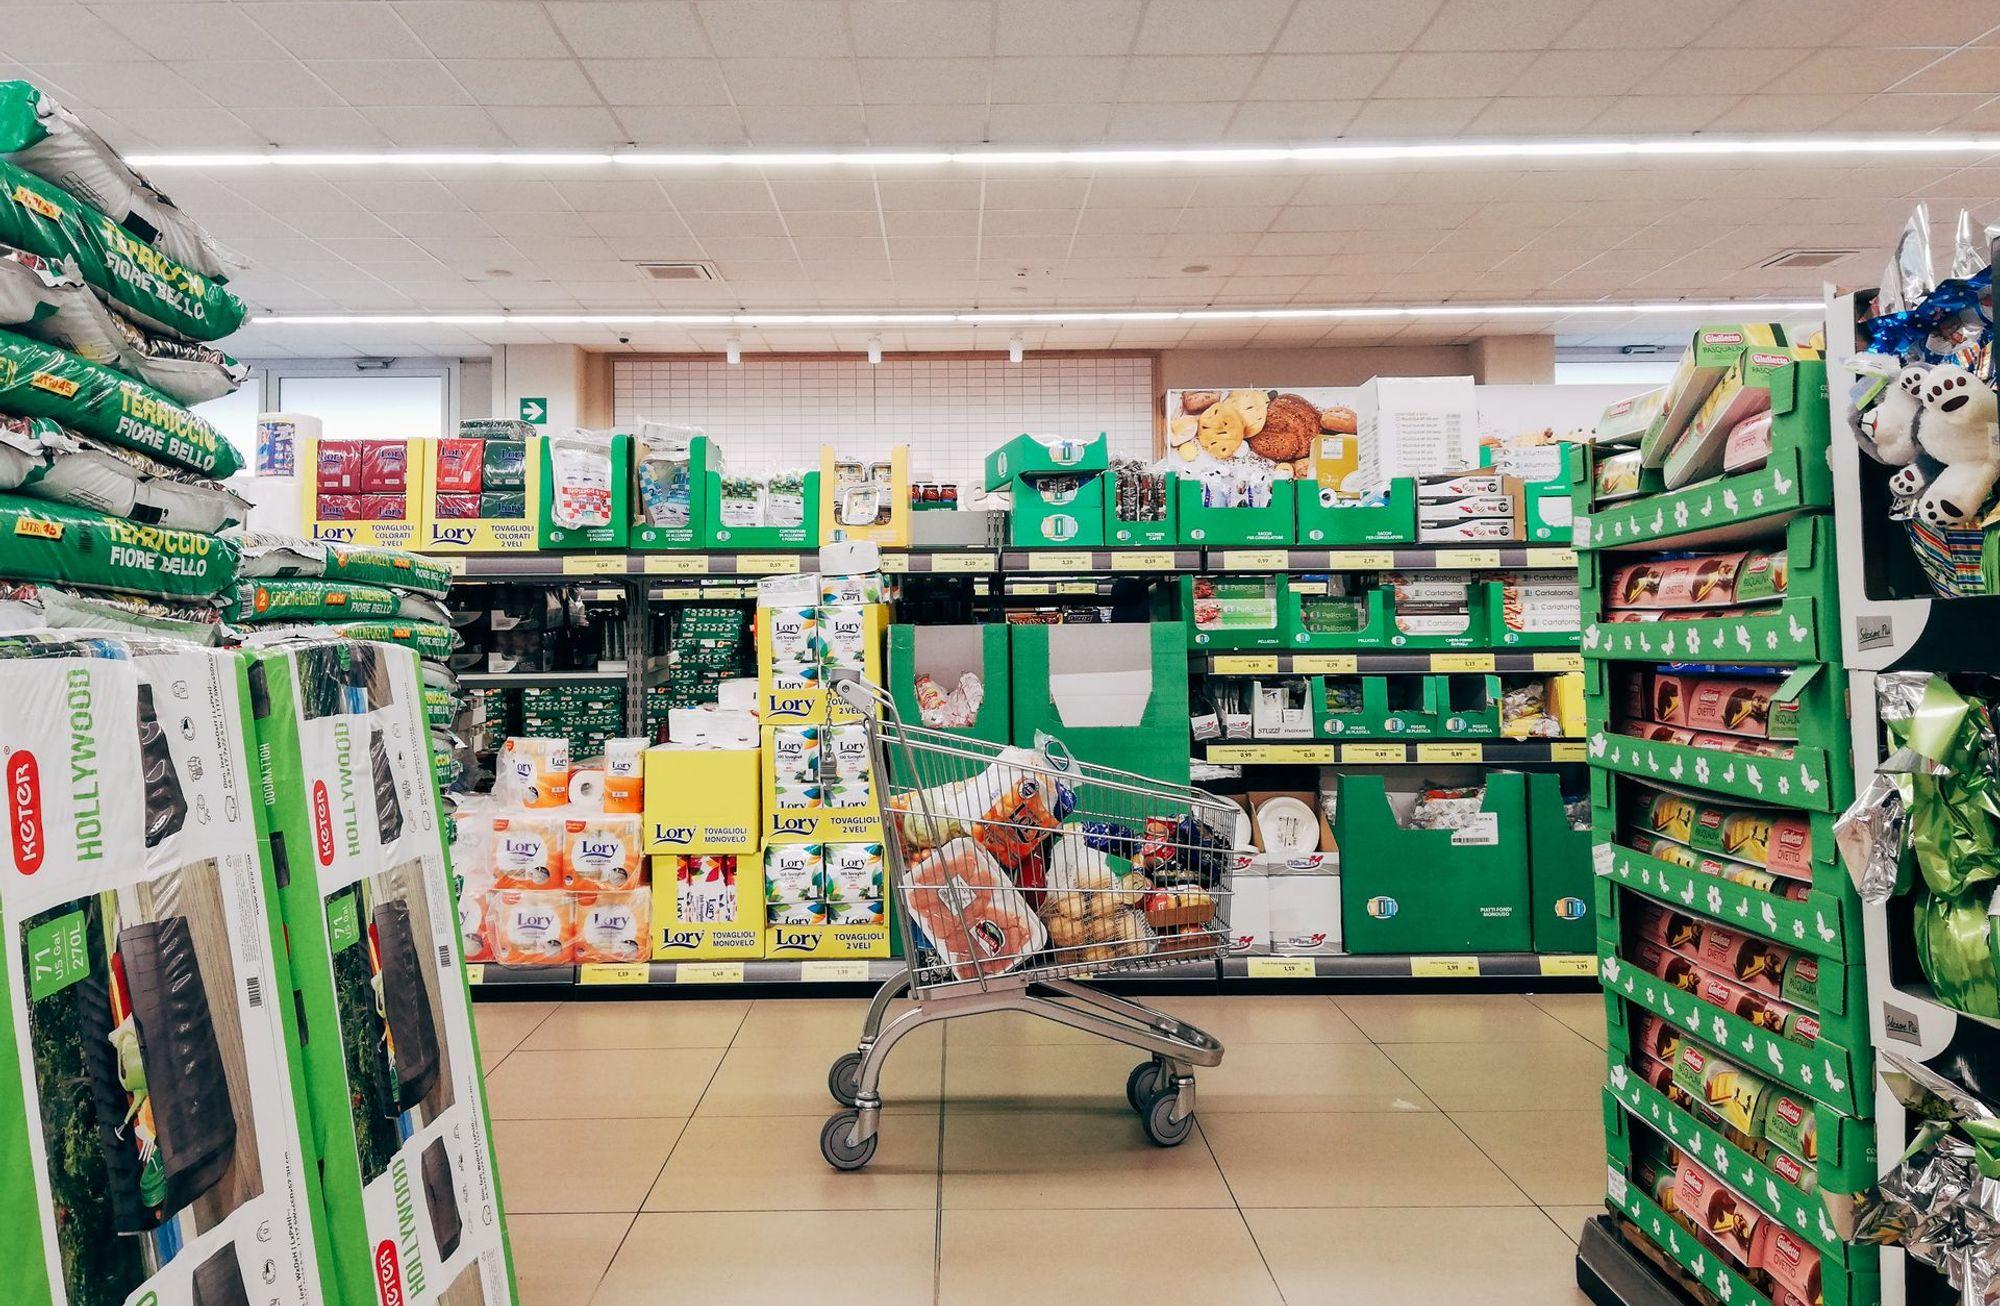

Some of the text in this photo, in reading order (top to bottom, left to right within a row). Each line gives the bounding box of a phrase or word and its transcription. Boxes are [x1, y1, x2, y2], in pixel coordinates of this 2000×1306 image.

[105, 250, 205, 320] FIORE BELLO
[119, 385, 216, 452] TERRICCIO
[116, 416, 166, 450] FIORE
[168, 439, 216, 471] BELLO
[103, 517, 210, 556] TERRICCIO
[313, 524, 357, 544] Lory
[374, 532, 411, 540] COLORATI
[432, 524, 477, 544] Lory
[490, 525, 534, 533] TOVAGLIOLI
[109, 546, 208, 577] FIORE BELLO
[350, 602, 392, 614] FIORE BELLO
[775, 622, 801, 634] Lory
[835, 622, 860, 634] Lory
[769, 695, 815, 717] Lory
[778, 741, 803, 753] Lory
[839, 741, 866, 753] Lory
[67, 666, 104, 862] HOLLYWOOD
[612, 761, 632, 771] Lory
[258, 742, 276, 806] HOLLYWOOD
[334, 721, 360, 858] HOLLYWOOD
[14, 762, 38, 862] KETER
[830, 816, 881, 825] TOVAGLIOLI
[313, 790, 333, 858] KETER
[656, 824, 696, 842] Lory
[704, 827, 747, 835] TOVAGLIOLI
[772, 814, 819, 835] Lory
[842, 825, 867, 833] 2 VELI
[506, 839, 541, 856] Lory
[582, 840, 619, 857] Lory
[1777, 849, 1800, 862] OVETTO
[780, 857, 806, 870] Lory
[840, 857, 867, 870] Lory
[333, 916, 345, 940] 71
[517, 912, 554, 928] Lory
[663, 929, 705, 948] Lory
[712, 931, 756, 939] TOVAGLIOLI
[712, 939, 755, 948] MONOVELO
[776, 929, 823, 951] Lory
[834, 932, 885, 941] TOVAGLIOLI
[68, 920, 84, 971] 270L
[1707, 947, 1727, 962] OVETTO
[50, 931, 65, 981] US Gal
[34, 947, 52, 984] 71
[392, 1158, 427, 1300] HOLLYWOOD
[1773, 1254, 1796, 1278] OVETTO
